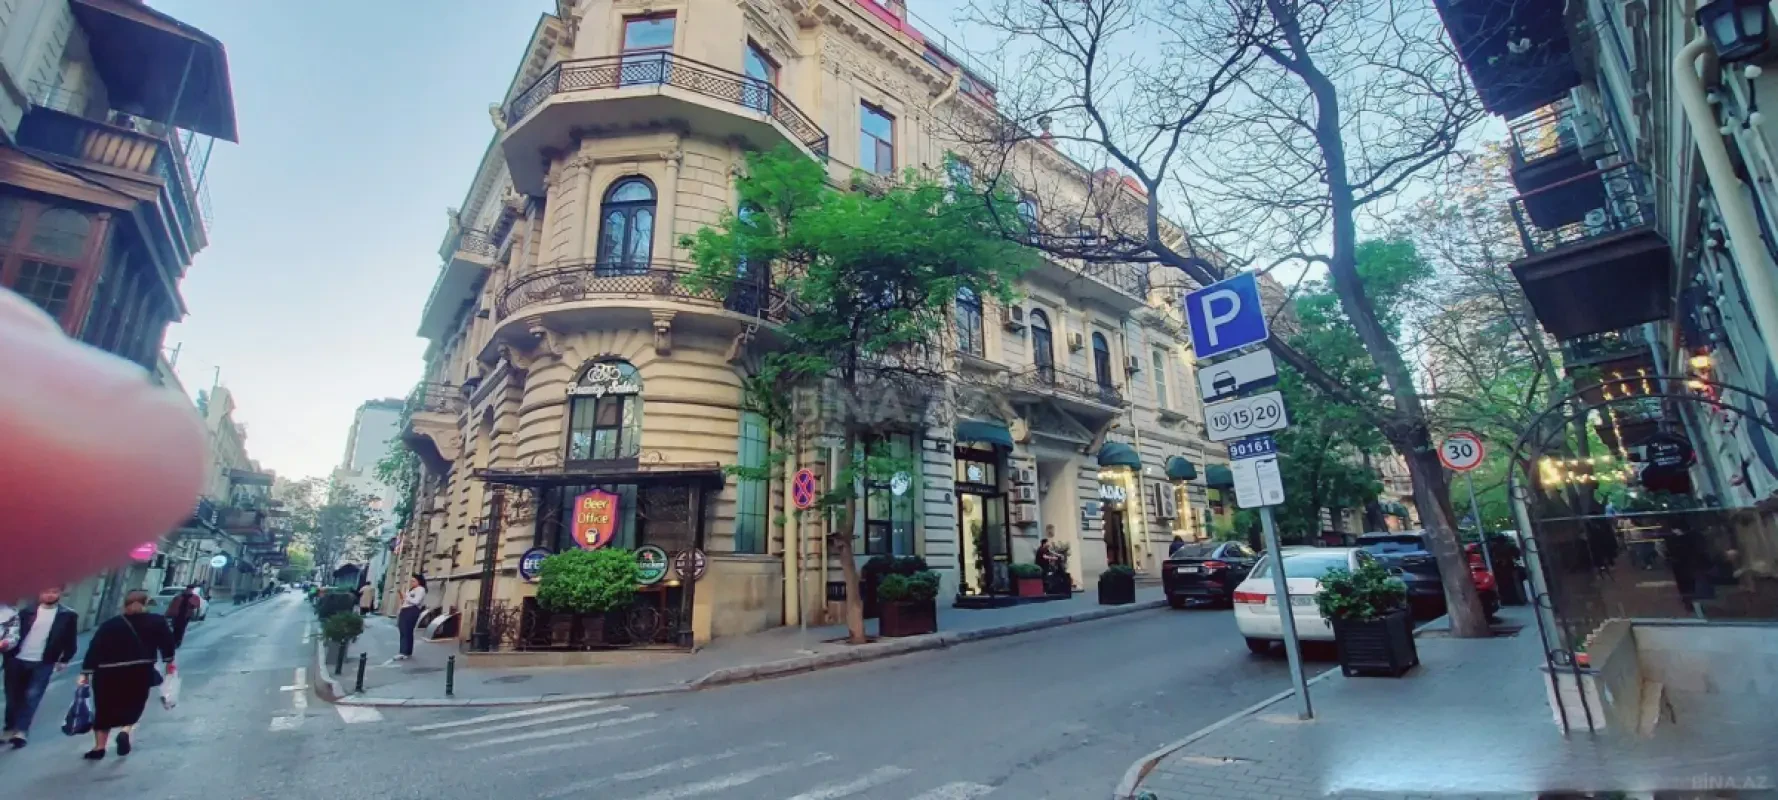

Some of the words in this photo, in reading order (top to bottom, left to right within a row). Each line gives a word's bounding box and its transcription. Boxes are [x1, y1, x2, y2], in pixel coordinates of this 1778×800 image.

[1201, 289, 1241, 347] P
[1213, 414, 1228, 428] 10
[1233, 409, 1249, 425] 15
[1255, 404, 1277, 420] 20
[1229, 439, 1271, 457] 90161
[1448, 443, 1473, 460] 30
[584, 497, 609, 509] Beer
[577, 512, 609, 524] Office
[522, 558, 540, 570] EFE
